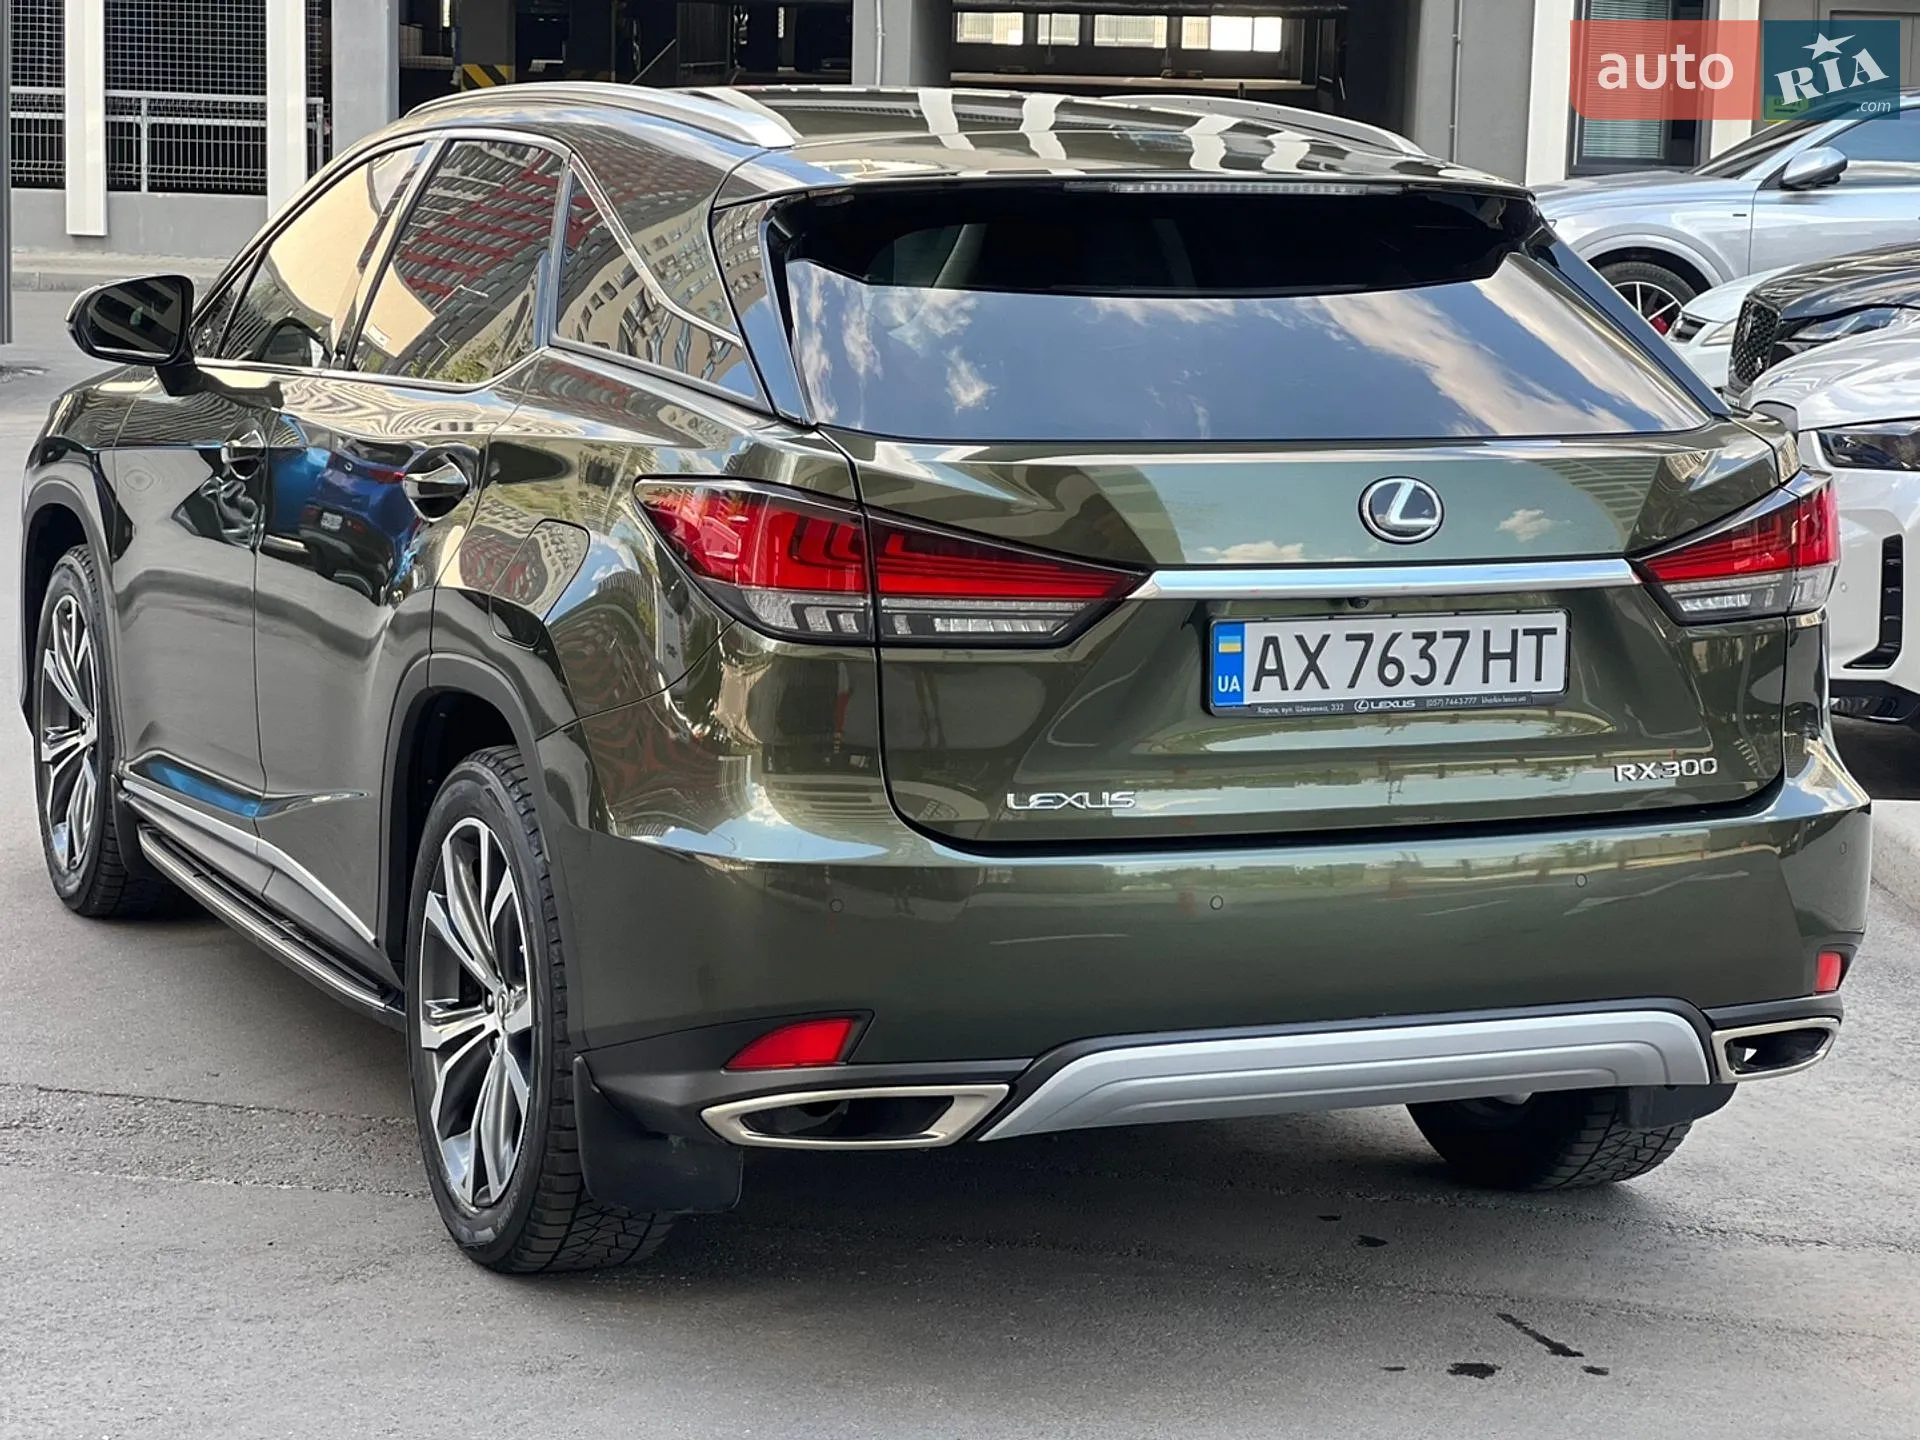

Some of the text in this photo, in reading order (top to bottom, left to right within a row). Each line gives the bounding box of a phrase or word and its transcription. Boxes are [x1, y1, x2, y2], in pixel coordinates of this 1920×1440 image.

[1252, 627, 1558, 692] AX 7637 HT
[1218, 675, 1241, 692] UA
[1370, 699, 1416, 709] LEXUS
[1614, 757, 1718, 782] RX 300
[1006, 791, 1136, 810] LEXUS
